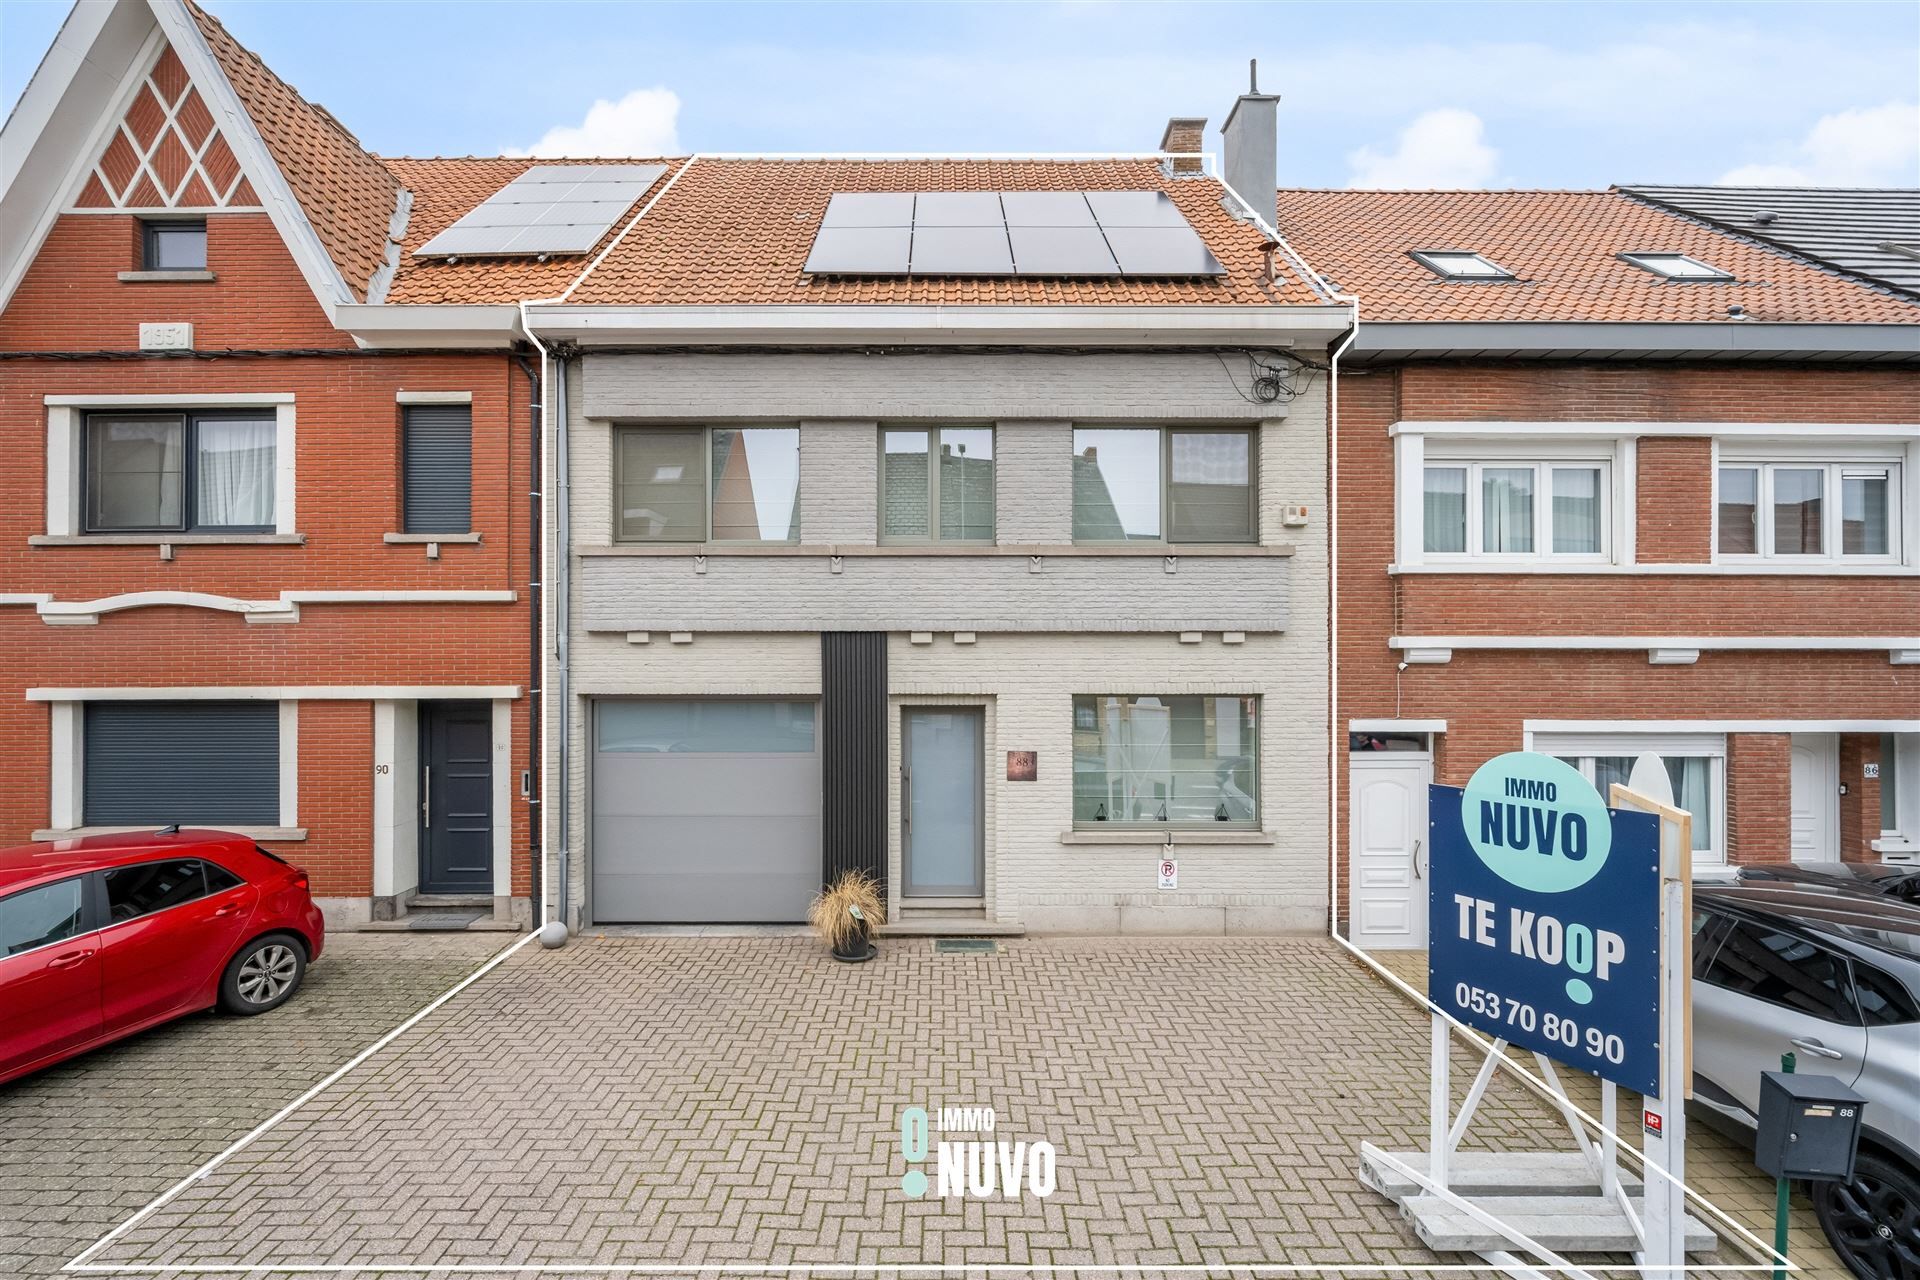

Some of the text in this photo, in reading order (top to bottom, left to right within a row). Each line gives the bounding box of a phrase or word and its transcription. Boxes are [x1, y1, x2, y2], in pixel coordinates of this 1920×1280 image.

[143, 328, 185, 345] 1951
[375, 764, 389, 775] 90
[1016, 758, 1029, 767] 88
[1865, 766, 1878, 775] 86
[1504, 777, 1557, 802] IMMO
[1480, 800, 1588, 861] NUVO
[1454, 893, 1626, 981] TE KOOP
[1455, 982, 1625, 1065] 053 70 80 90
[1839, 1109, 1854, 1117] 88
